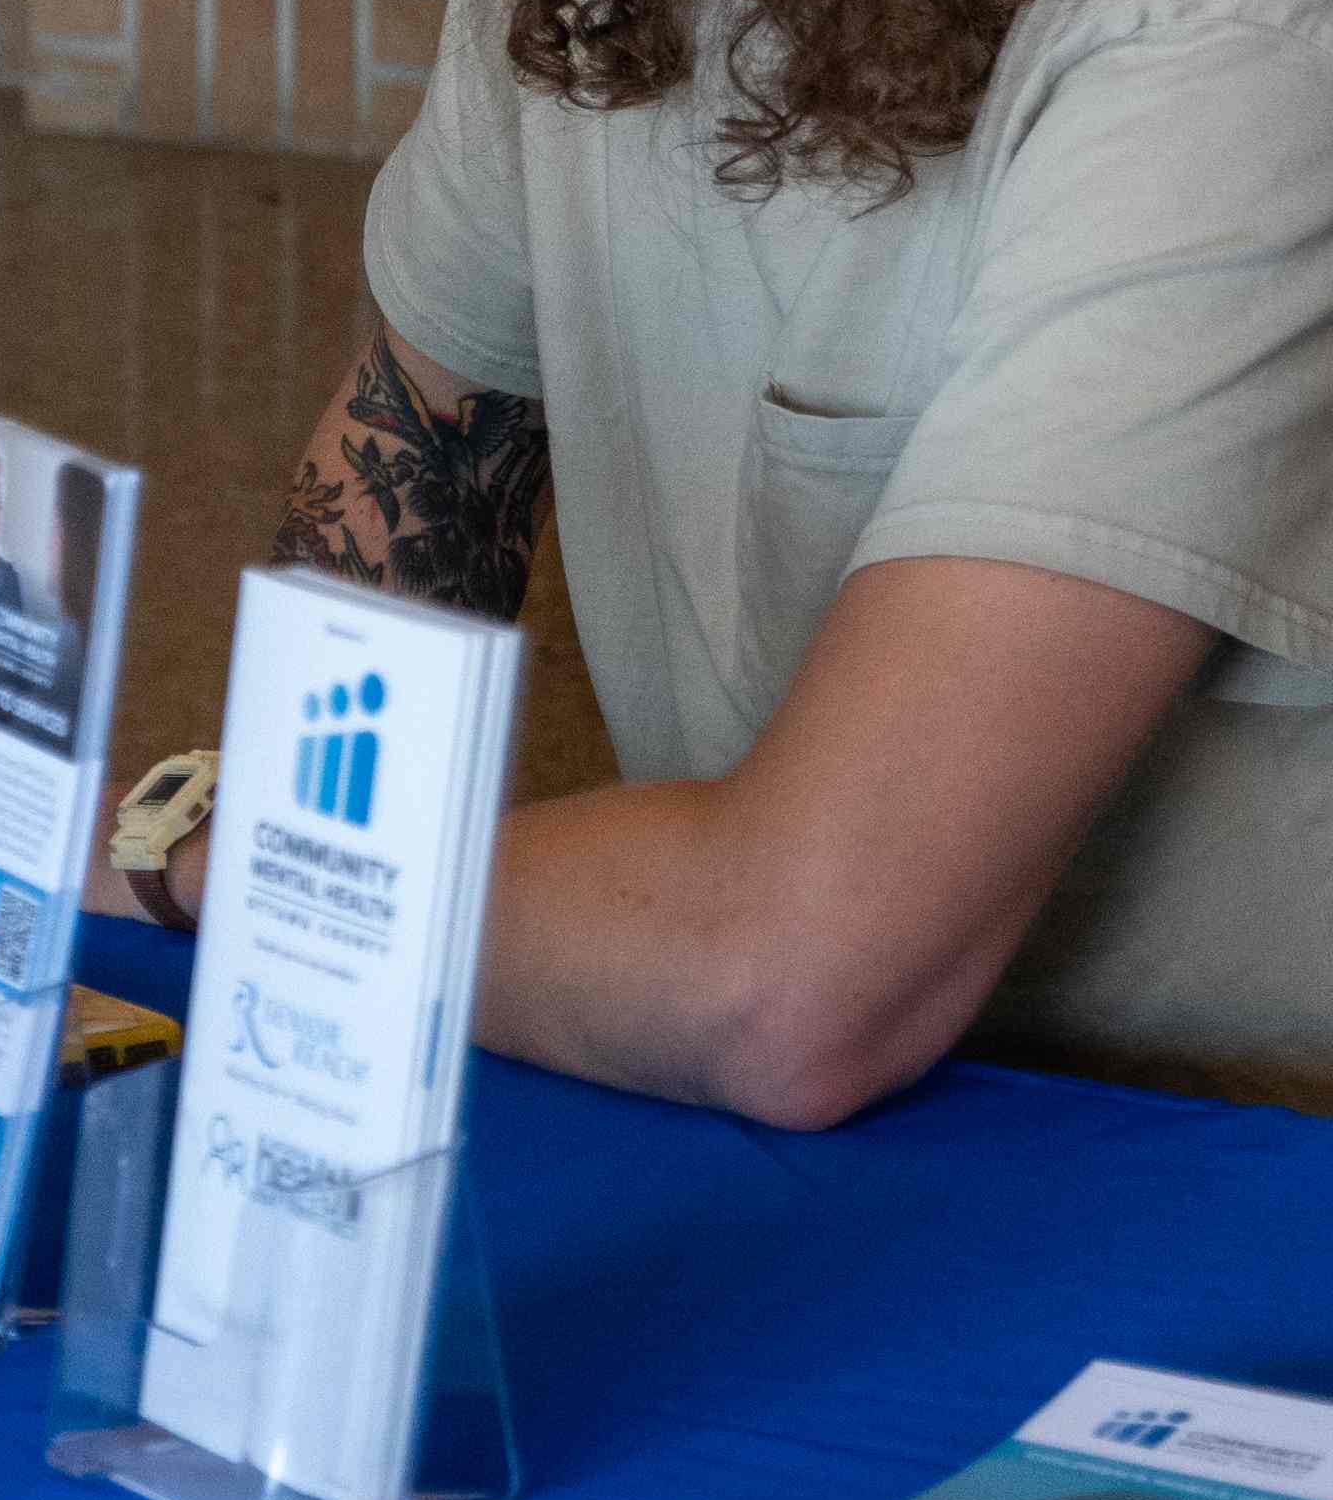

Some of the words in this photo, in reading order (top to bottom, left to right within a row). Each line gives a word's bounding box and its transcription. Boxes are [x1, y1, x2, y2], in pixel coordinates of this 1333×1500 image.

[250, 856, 318, 899] MENTAL
[324, 883, 396, 921] HEALTH
[253, 820, 401, 891] COMMUNITY
